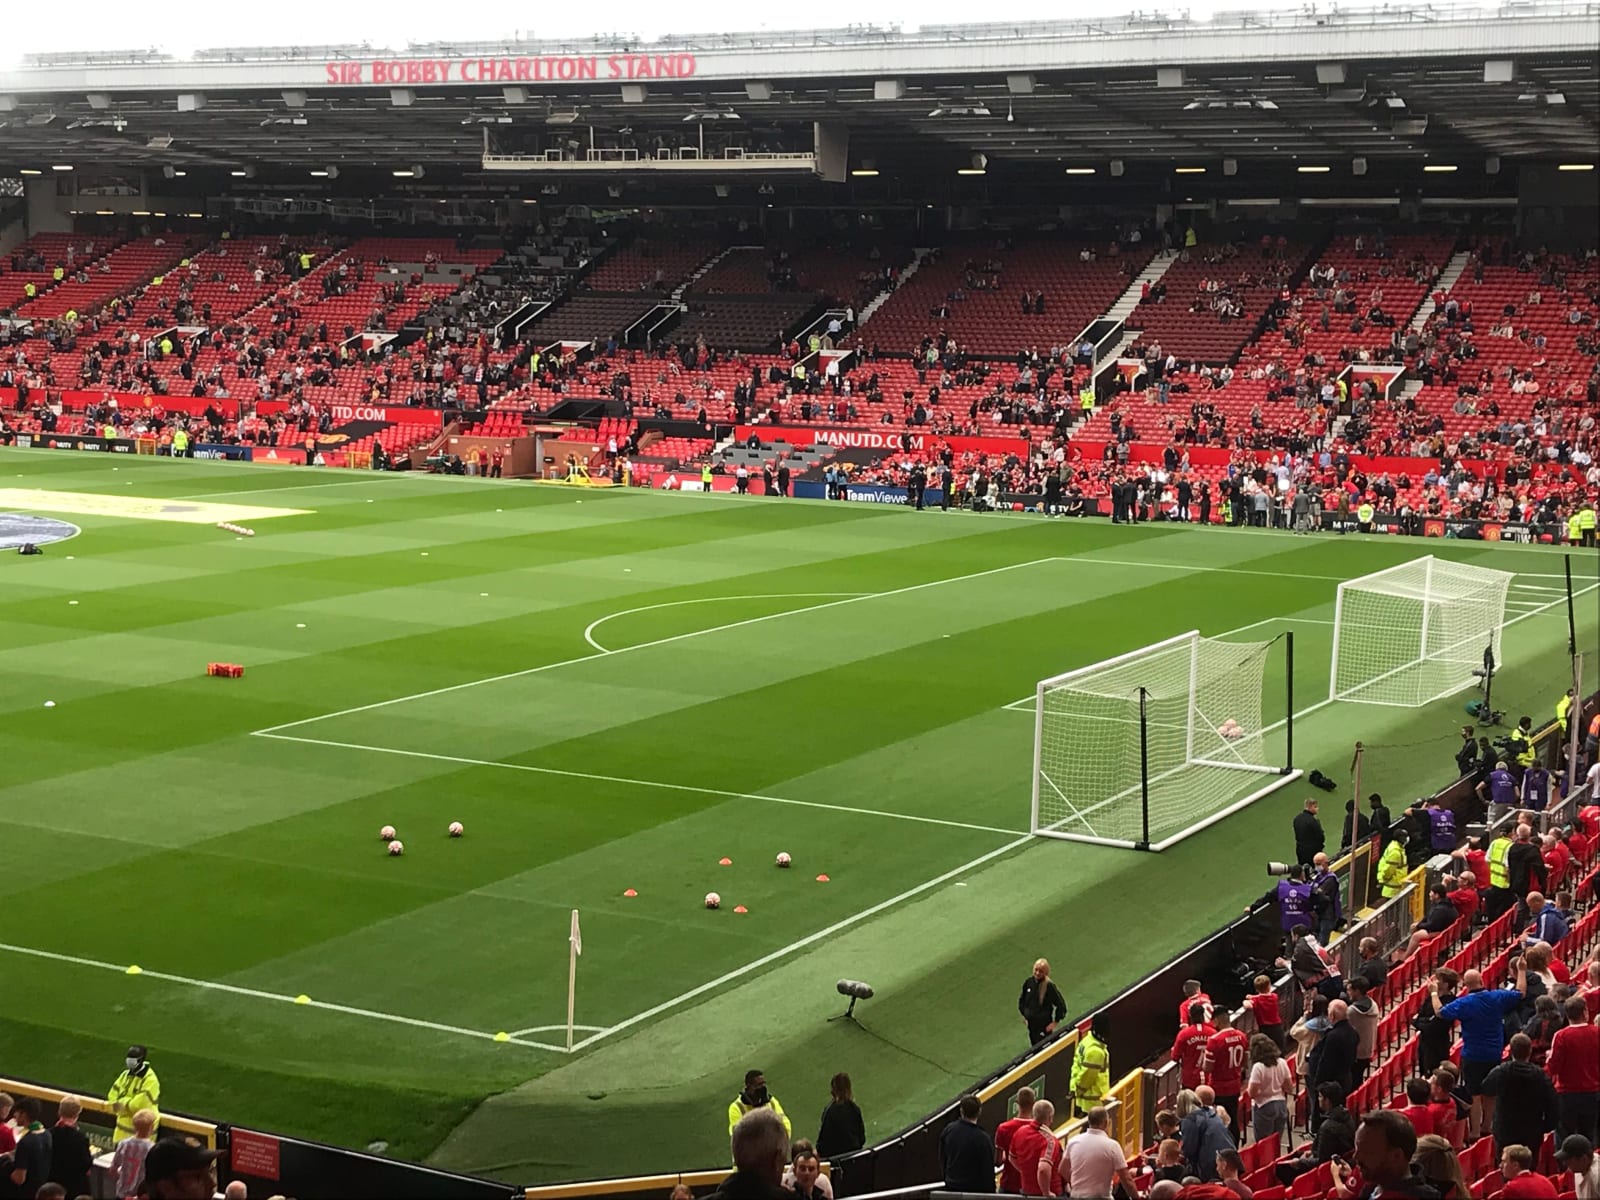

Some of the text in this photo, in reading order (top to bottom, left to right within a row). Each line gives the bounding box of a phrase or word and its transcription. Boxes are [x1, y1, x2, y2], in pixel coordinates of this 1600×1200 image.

[326, 53, 696, 84] SIR BOBBY CHARLTON STAND
[846, 489, 908, 504] TeamViewe
[1228, 1044, 1244, 1069] 10
[126, 1156, 141, 1185] 7
